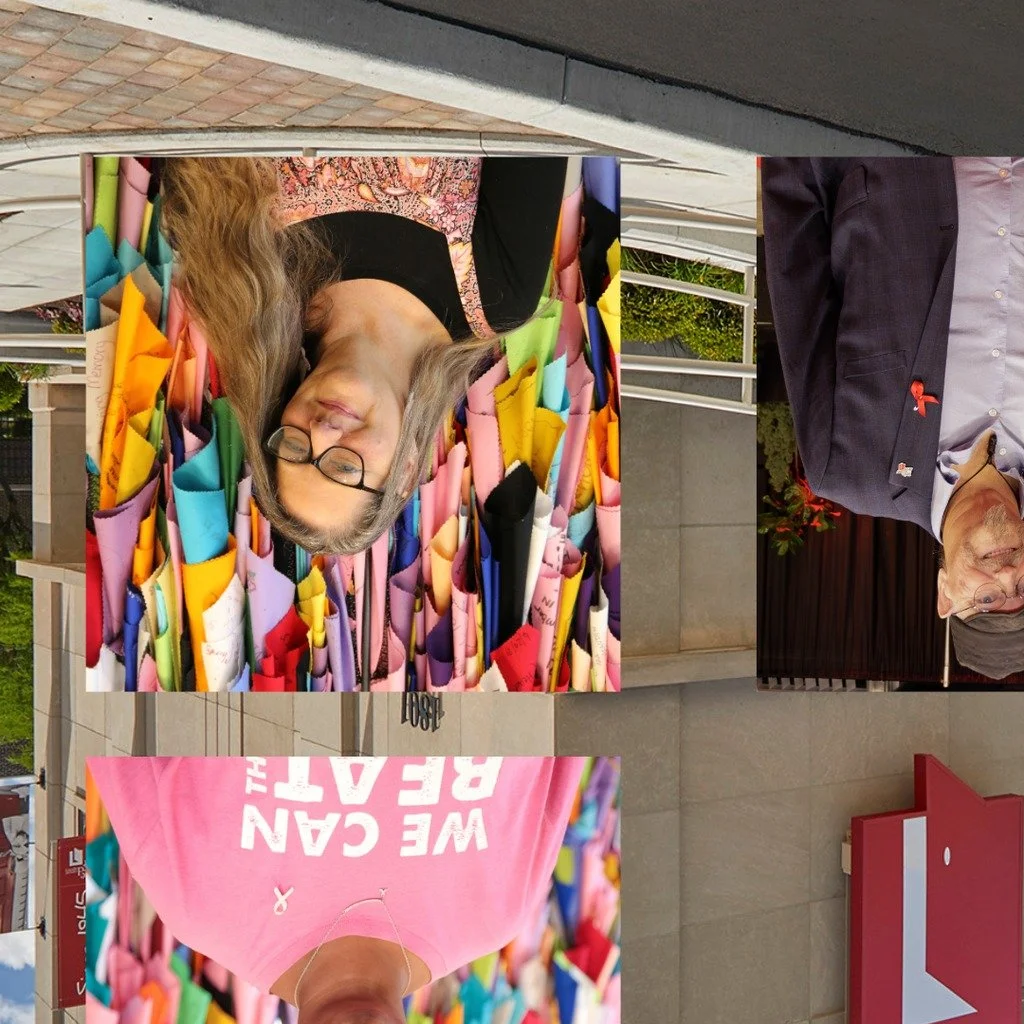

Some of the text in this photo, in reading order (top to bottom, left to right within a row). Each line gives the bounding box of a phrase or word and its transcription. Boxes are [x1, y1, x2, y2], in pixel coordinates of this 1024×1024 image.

[401, 692, 441, 732] 1801
[240, 804, 488, 858] WE CAN
